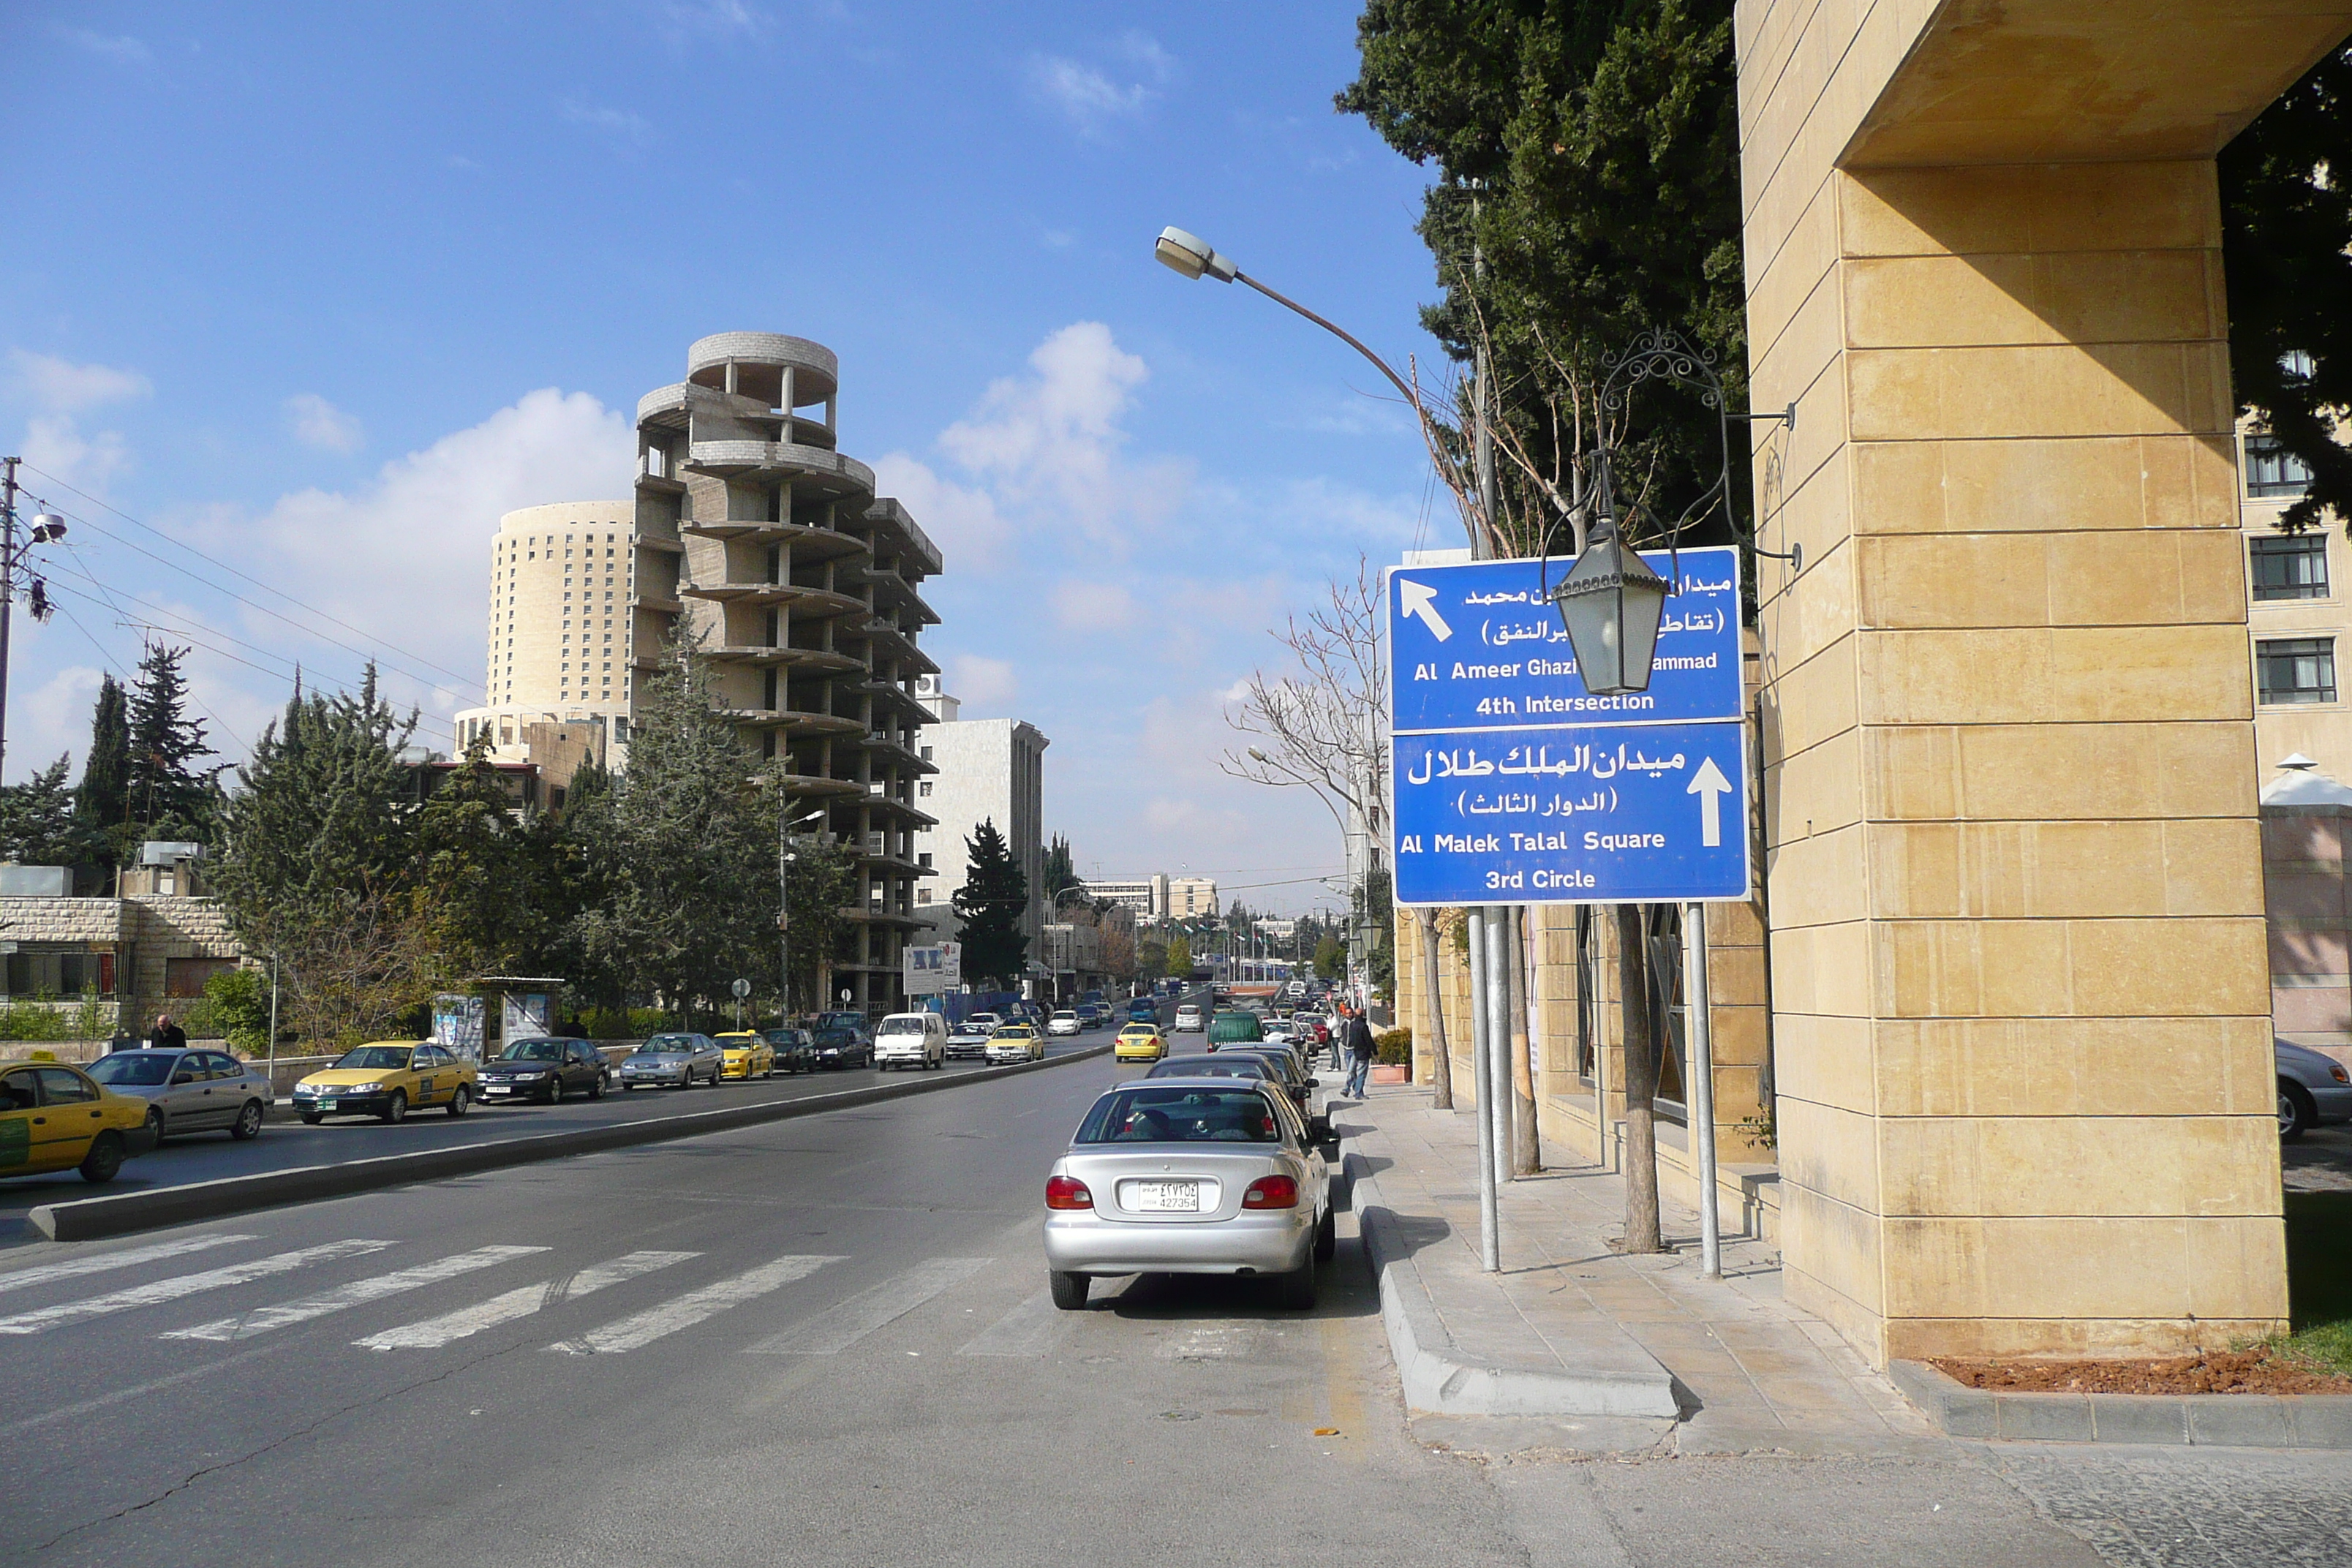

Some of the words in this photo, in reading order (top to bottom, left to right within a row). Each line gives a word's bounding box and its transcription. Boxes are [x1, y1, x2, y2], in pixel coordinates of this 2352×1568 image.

[1465, 590, 1527, 606] محمد
[1547, 628, 1569, 644] بر
[1414, 663, 1438, 681] Al
[1450, 661, 1521, 680] Ameer
[1527, 657, 1578, 676] Ghazi
[1652, 652, 1717, 671] ammad
[1476, 696, 1515, 715] 4th
[1526, 694, 1654, 714] Intersection
[1408, 748, 1495, 785] طلال
[1499, 744, 1589, 777] الملك
[1592, 744, 1686, 778] ميدان
[1458, 789, 1536, 818] الثالث)
[1540, 785, 1618, 817] (الدوار
[1400, 834, 1423, 853] Al
[1434, 833, 1500, 853] Malek
[1509, 832, 1567, 851] Talal
[1583, 832, 1665, 851] Square
[1485, 870, 1523, 889] 3rd
[1532, 870, 1596, 889] Circle
[1160, 1198, 1196, 1208] 427354
